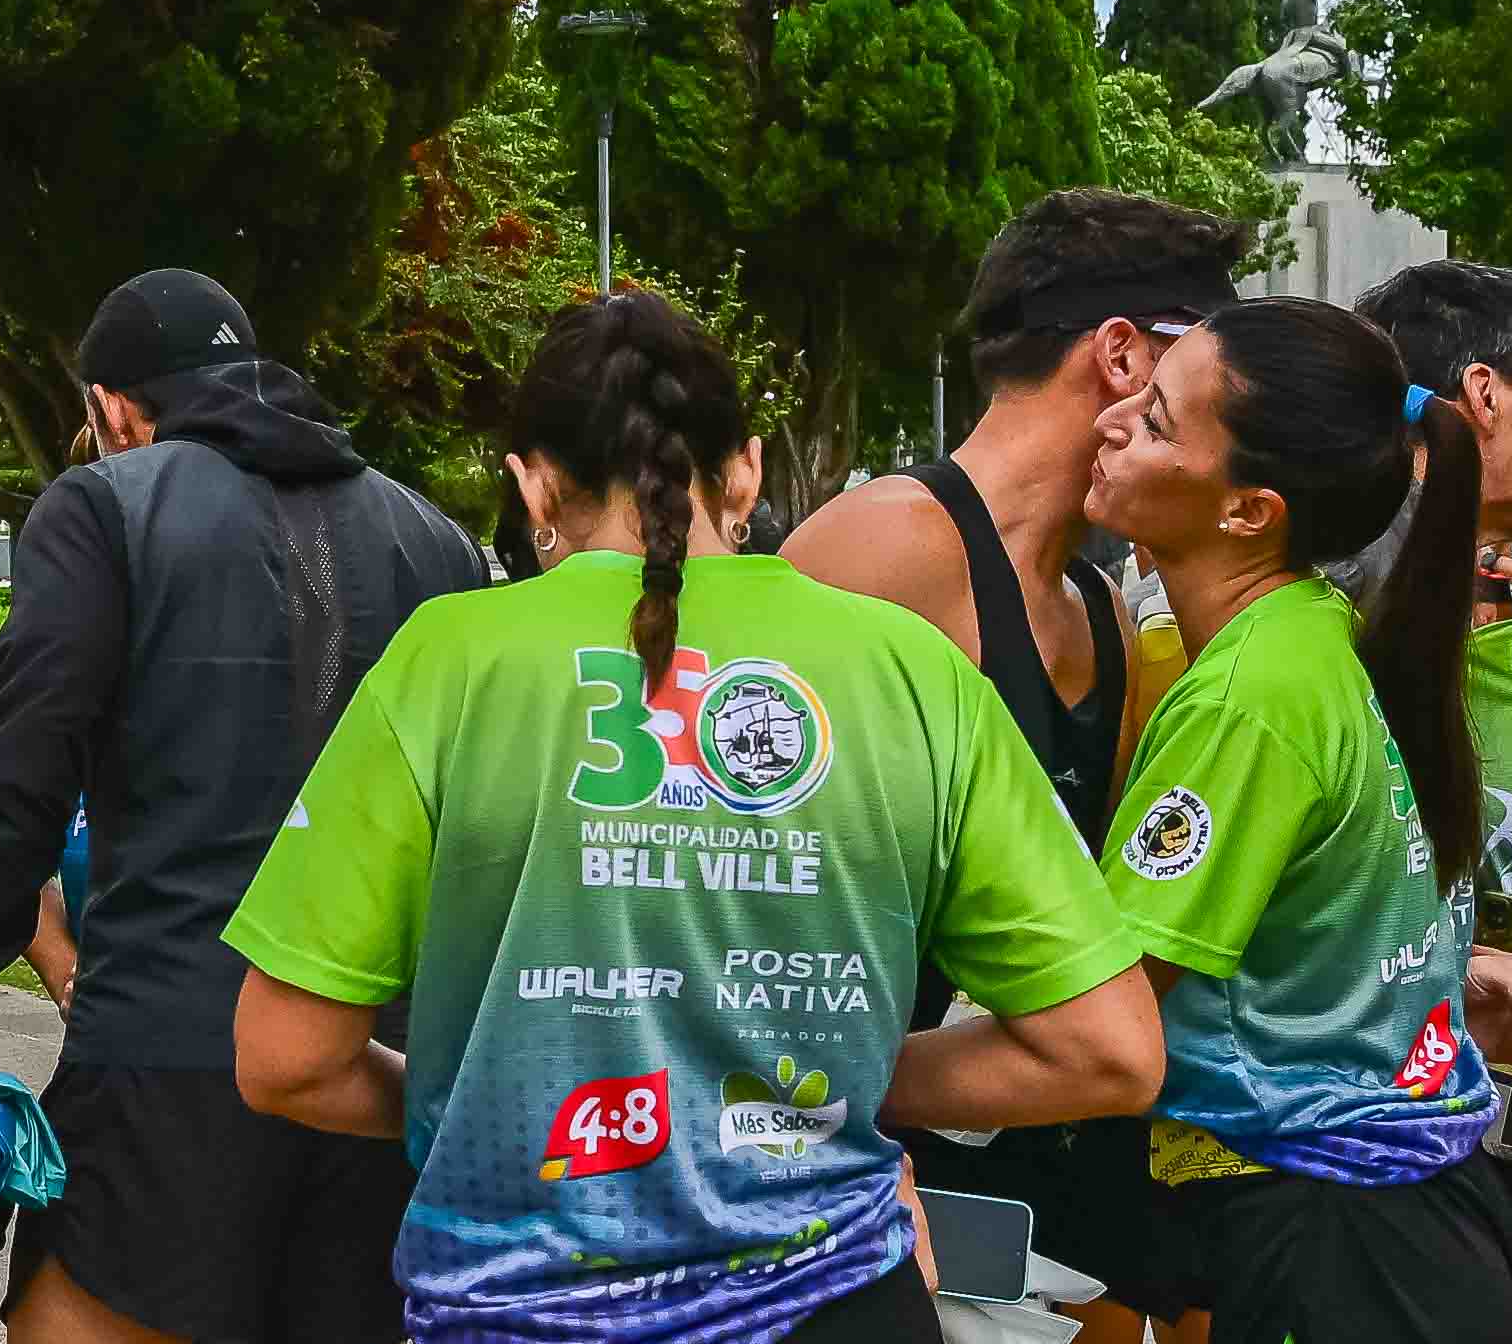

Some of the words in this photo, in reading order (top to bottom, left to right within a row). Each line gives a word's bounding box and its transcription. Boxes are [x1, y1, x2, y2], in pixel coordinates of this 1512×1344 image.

[660, 778, 704, 806] AÑOS
[580, 821, 778, 849] MUNICIPALIDAD
[788, 830, 822, 852] DE
[581, 847, 687, 890] BELL
[697, 851, 821, 895] VILLE
[725, 949, 868, 979] POSTA
[518, 966, 684, 1000] WALHER
[715, 983, 873, 1013] NATIVA
[568, 1088, 659, 1154] 4:8
[731, 1112, 766, 1136] Más
